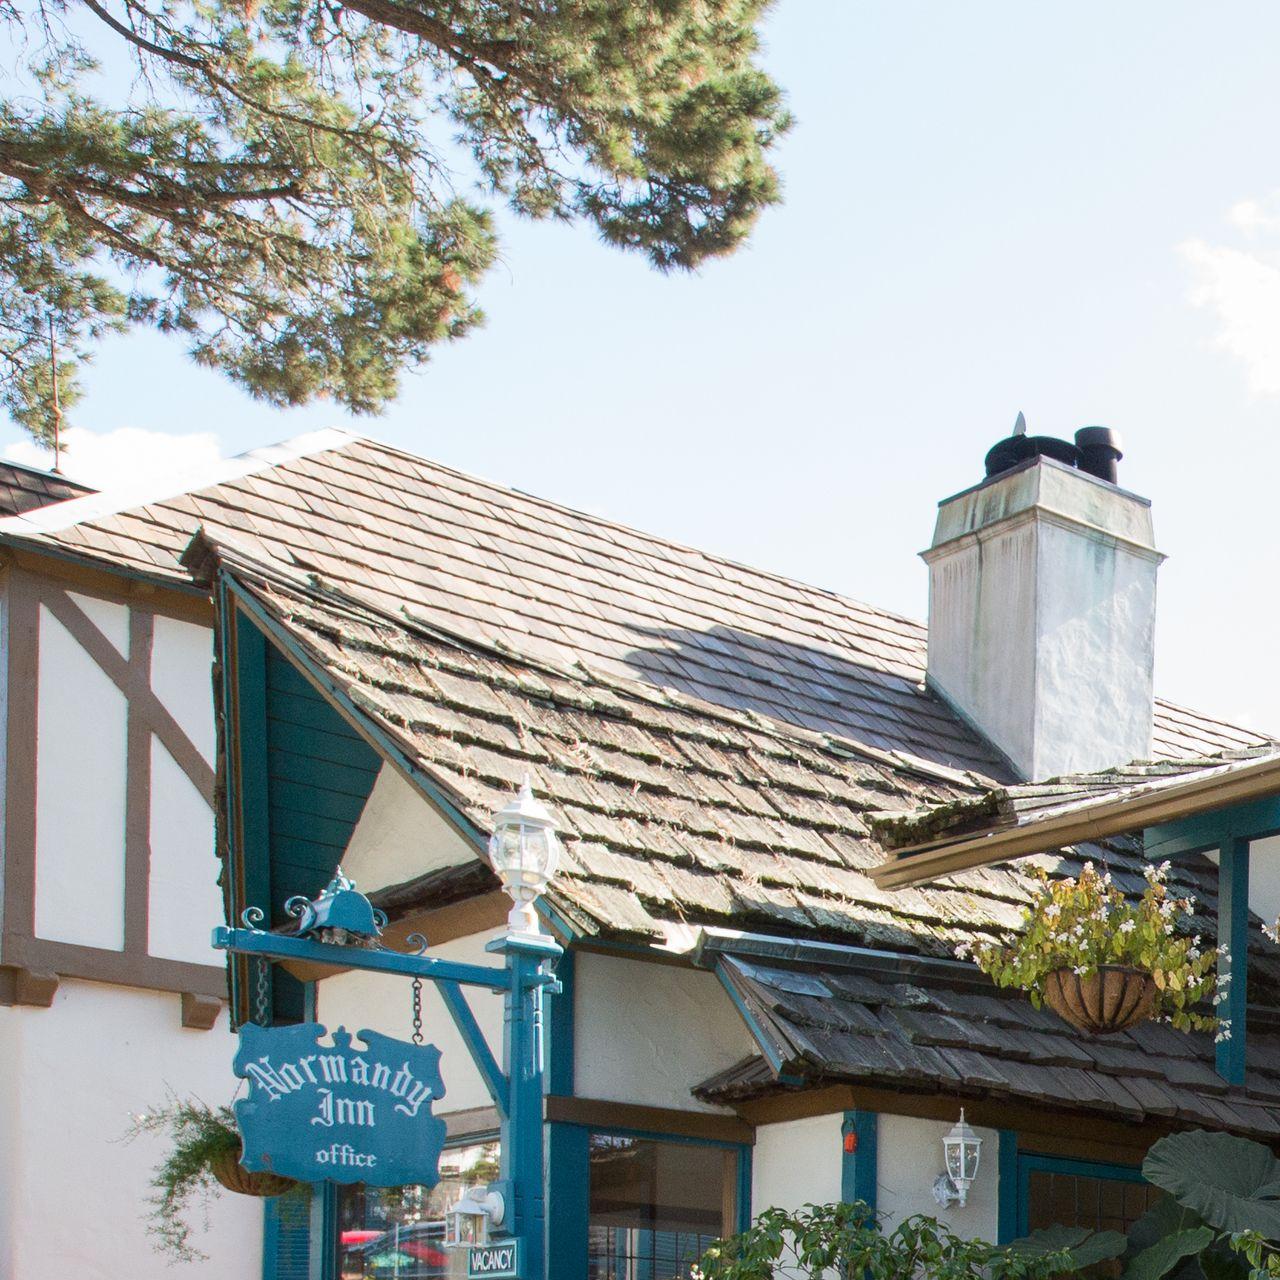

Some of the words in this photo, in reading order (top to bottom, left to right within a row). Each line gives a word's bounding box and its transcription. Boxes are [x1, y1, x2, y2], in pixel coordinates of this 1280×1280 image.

[244, 1053, 433, 1117] Normandy
[311, 1087, 376, 1128] Inn
[315, 1142, 377, 1168] office
[471, 1248, 514, 1272] VACANCY
